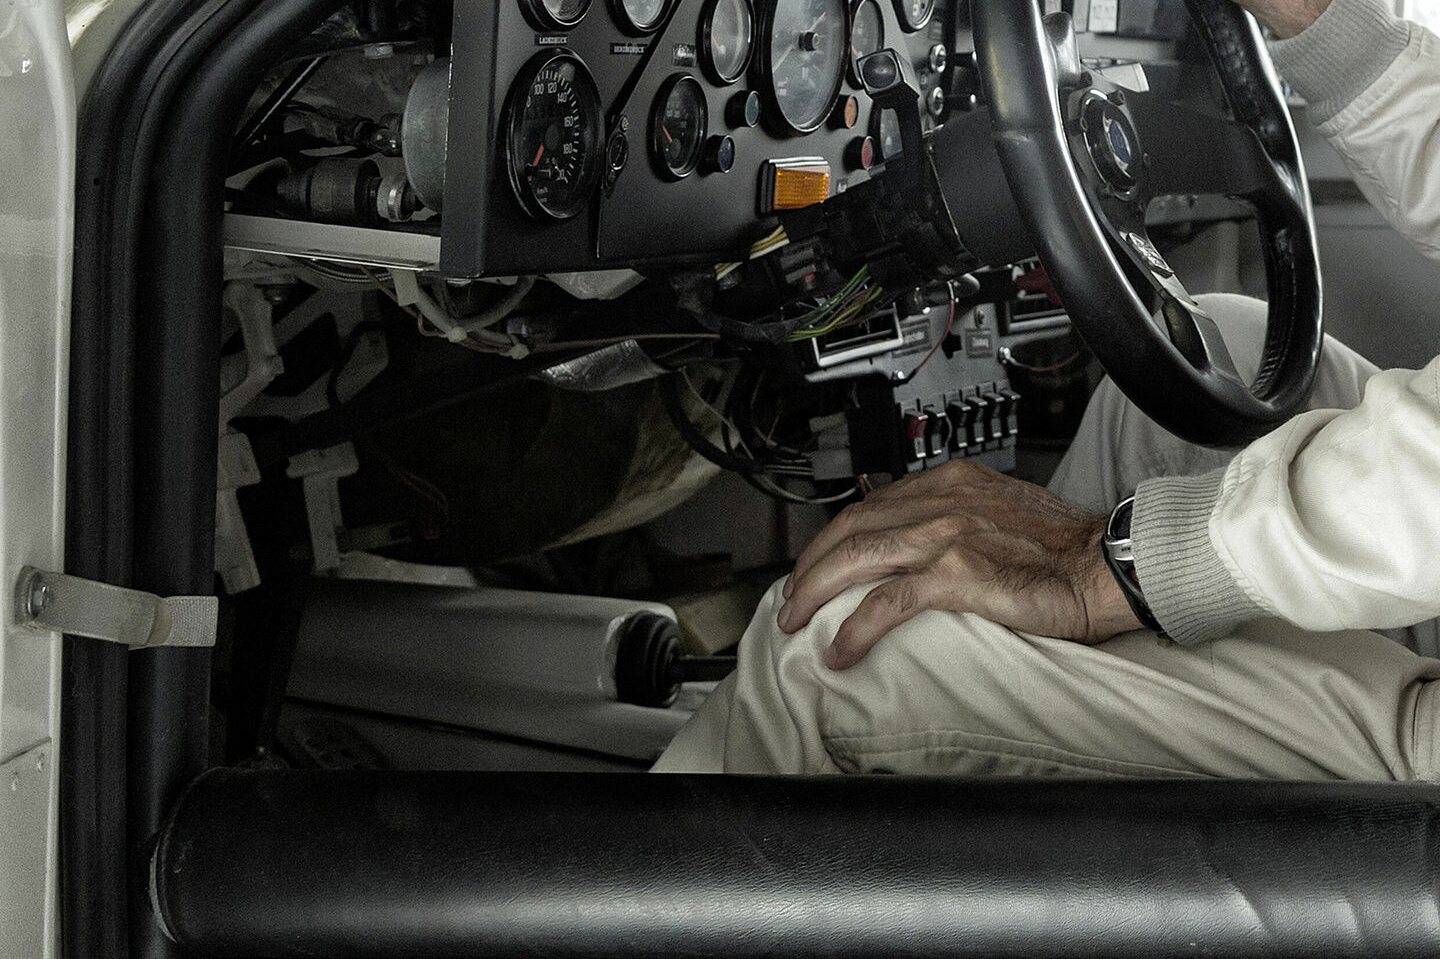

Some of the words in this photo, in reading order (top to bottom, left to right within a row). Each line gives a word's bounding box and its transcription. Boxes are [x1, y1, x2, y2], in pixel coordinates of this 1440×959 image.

[534, 83, 545, 94] 100
[548, 82, 558, 93] 120
[557, 91, 568, 102] 140
